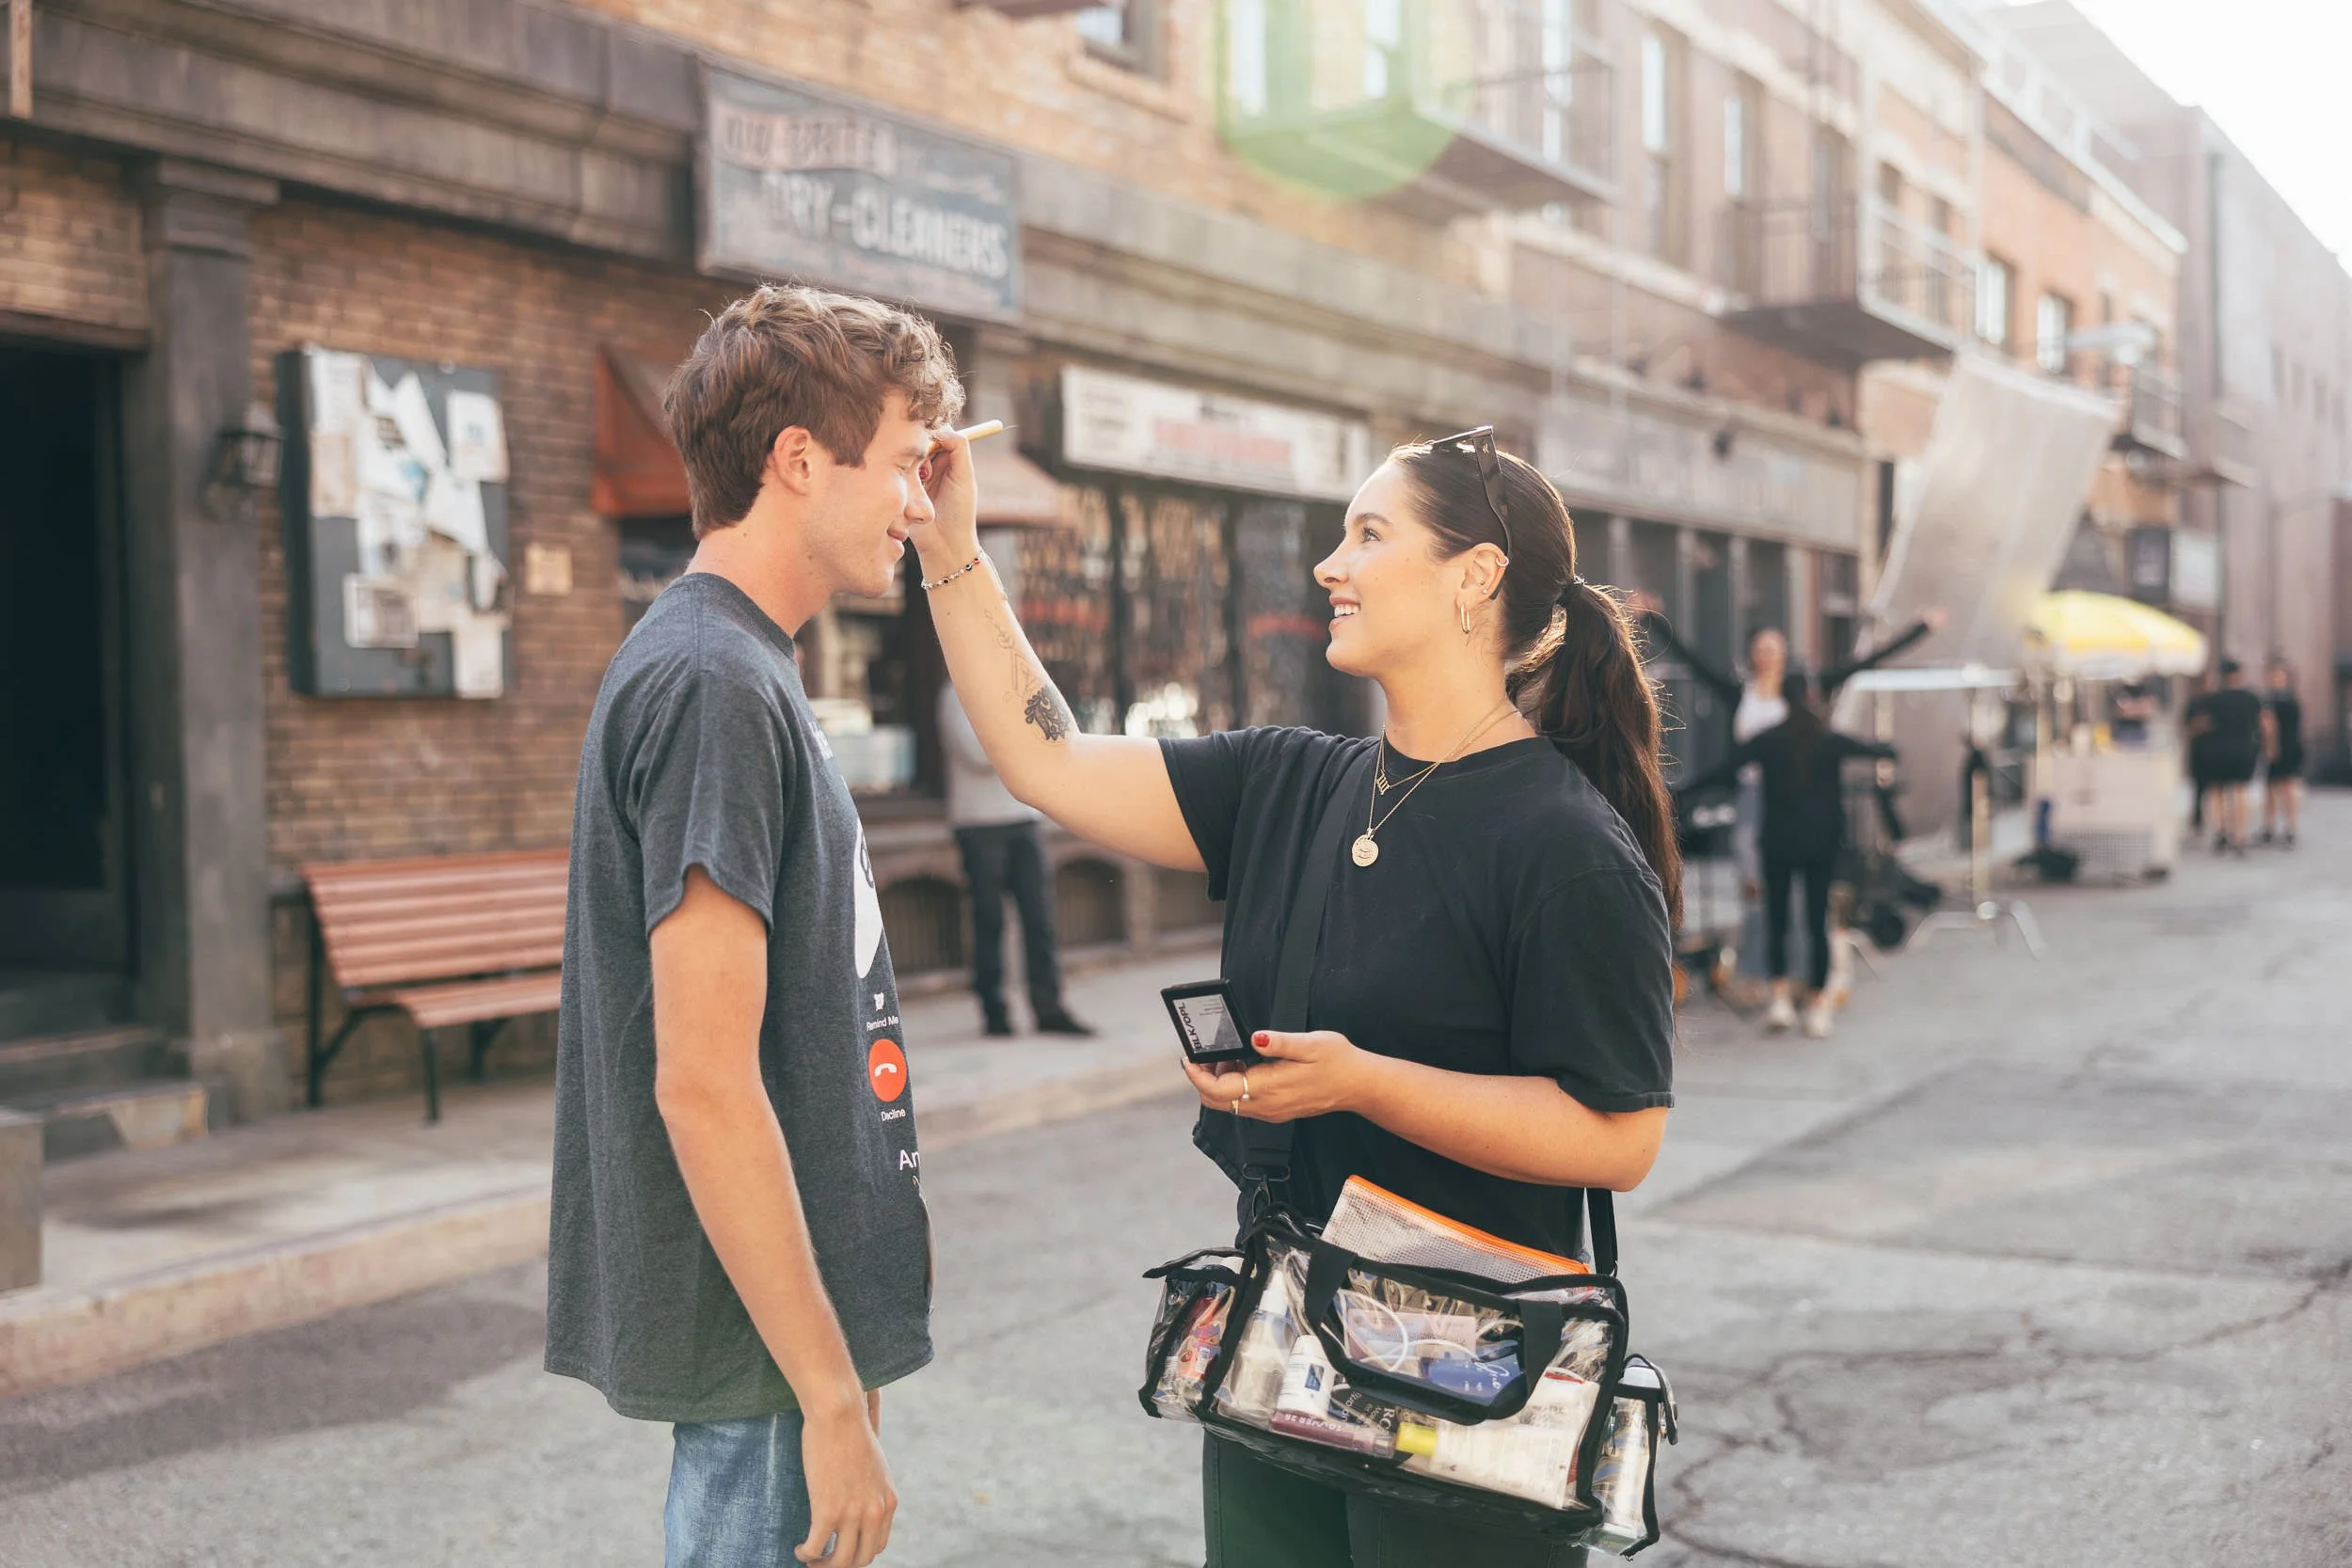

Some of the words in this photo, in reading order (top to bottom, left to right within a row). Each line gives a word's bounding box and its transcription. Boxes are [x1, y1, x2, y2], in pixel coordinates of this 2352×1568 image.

[866, 1017, 887, 1032] Remind
[888, 1016, 899, 1026] Me
[1179, 1002, 1202, 1052] BLK/OPL
[881, 1109, 906, 1121] Decline
